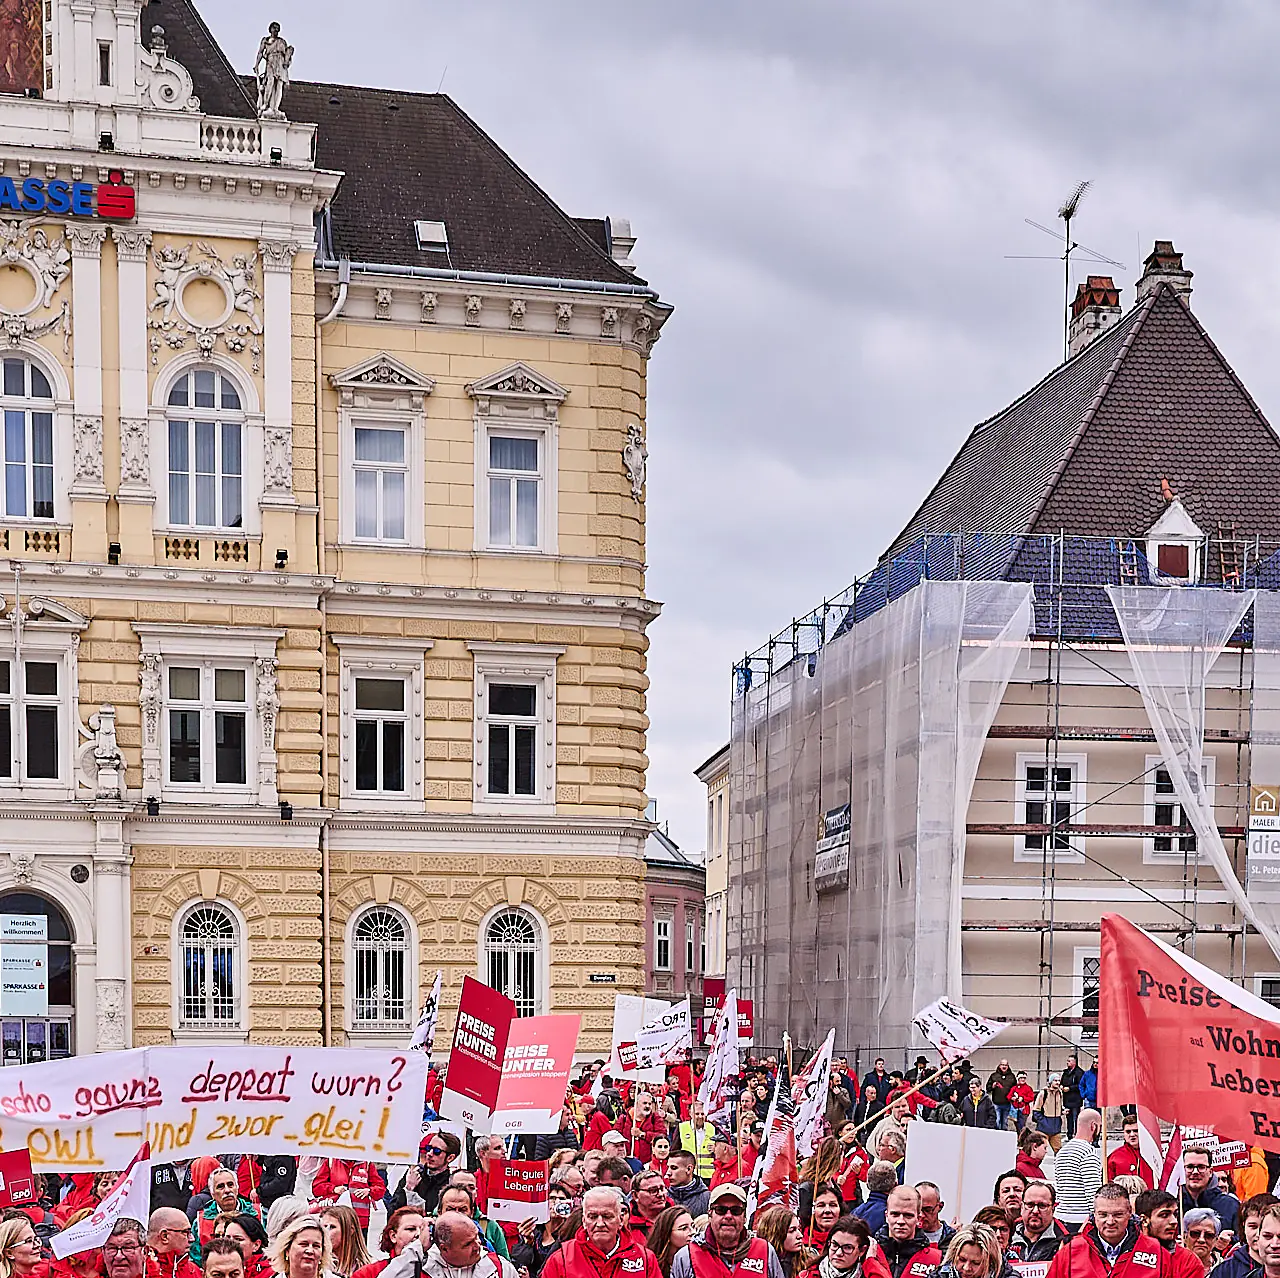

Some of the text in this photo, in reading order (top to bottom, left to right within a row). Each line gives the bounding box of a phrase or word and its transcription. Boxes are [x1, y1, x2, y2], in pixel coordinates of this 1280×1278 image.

[1252, 834, 1280, 854] die
[10, 919, 37, 927] Herzlich
[1137, 969, 1221, 1010] Preise
[459, 1012, 496, 1042] PREISE
[454, 1029, 497, 1061] RUNTER
[504, 1044, 549, 1059] REISE
[502, 1058, 556, 1074] UNTER
[188, 1055, 295, 1102] deppat
[504, 1167, 520, 1178] Ein
[504, 1180, 534, 1192] Leben
[12, 1189, 31, 1200] SPÖ
[622, 1257, 644, 1270] SPÖ
[1133, 1250, 1157, 1264] SPÖ
